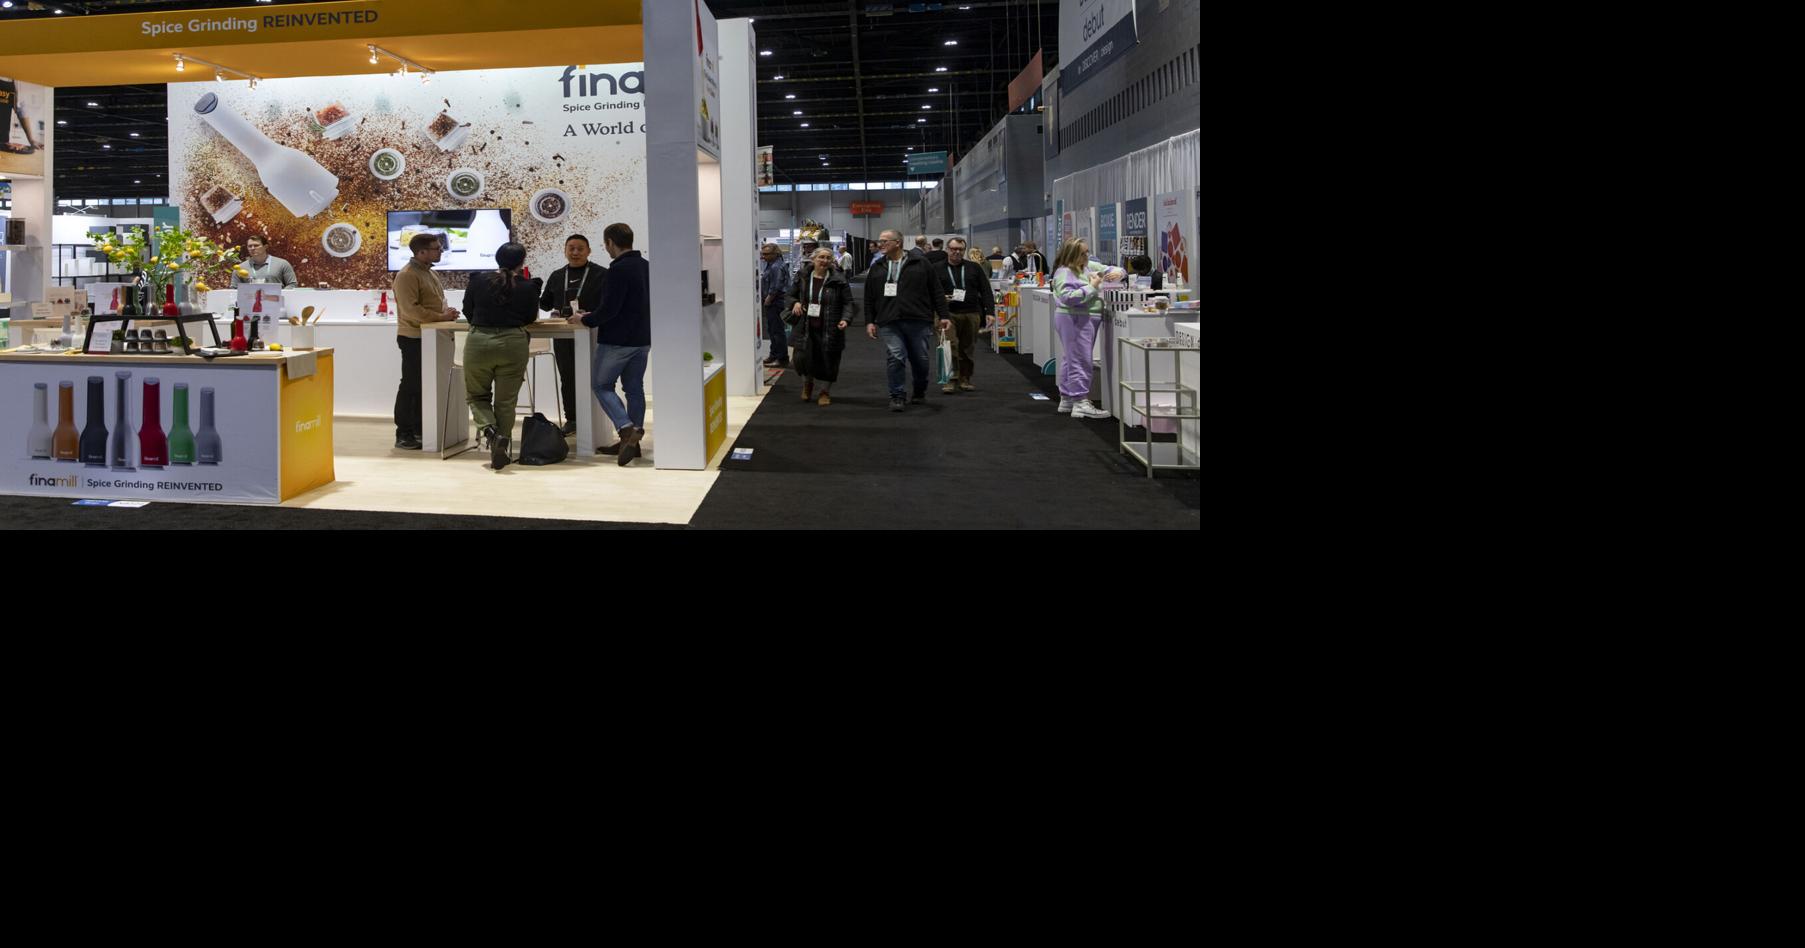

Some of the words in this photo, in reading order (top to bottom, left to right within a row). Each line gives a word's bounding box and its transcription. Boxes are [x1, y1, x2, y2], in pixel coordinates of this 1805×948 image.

[141, 21, 183, 37] Spice
[188, 17, 258, 33] Grinding
[263, 9, 379, 28] REINVENTED
[563, 104, 591, 113] Spice
[594, 101, 640, 110] Grinding
[563, 124, 577, 137] A
[582, 121, 634, 136] World
[29, 473, 77, 488] finamill
[87, 478, 111, 489] Spice
[114, 479, 154, 491] Grinding
[157, 481, 222, 491] REINVENTED
